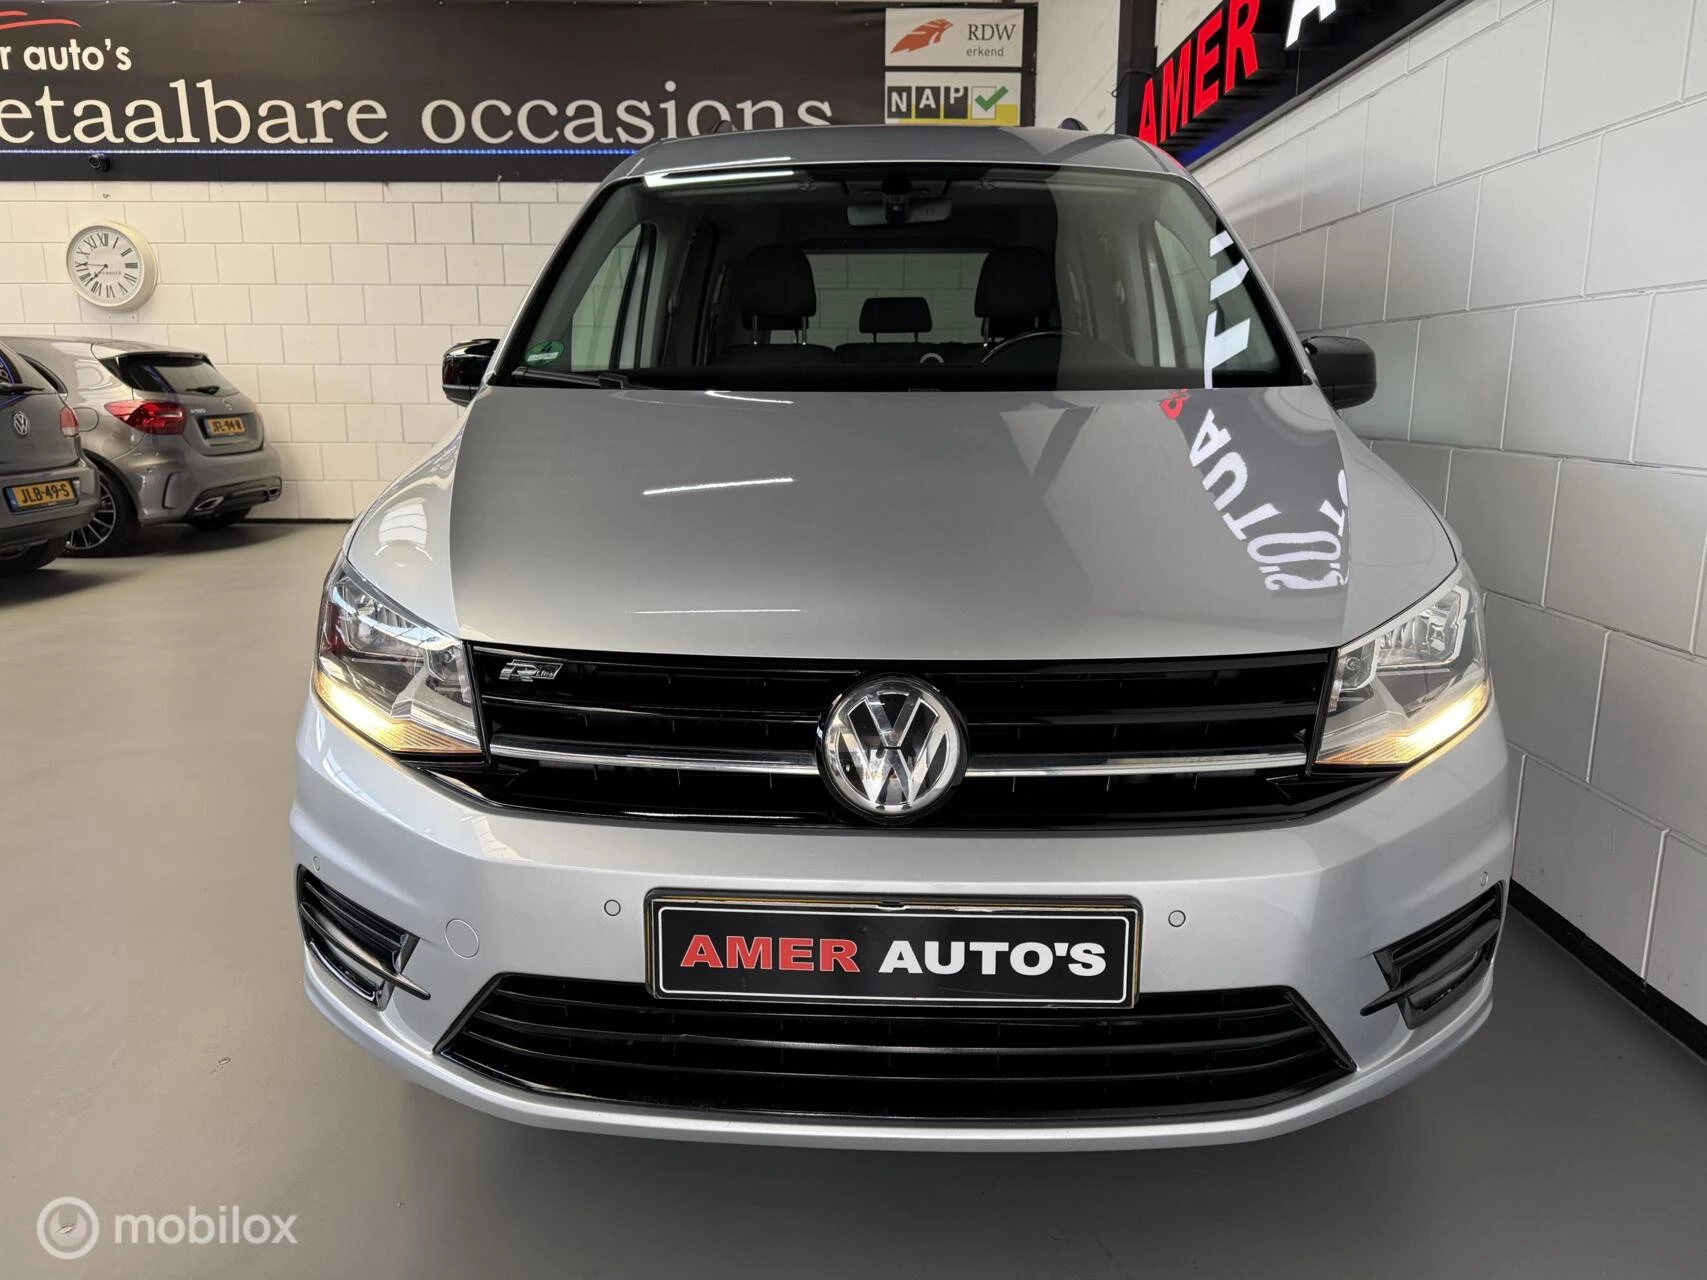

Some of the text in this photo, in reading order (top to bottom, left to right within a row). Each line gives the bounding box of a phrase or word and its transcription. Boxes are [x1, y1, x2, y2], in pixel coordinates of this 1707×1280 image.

[967, 23, 1016, 41] RDW
[23, 38, 132, 71] auto's
[966, 47, 1004, 57] erkend
[1138, 0, 1260, 147] AMER
[0, 78, 832, 144] etaalbare occasions
[21, 483, 70, 503] JLB-49-S
[679, 934, 1107, 977] AMER AUTO'S
